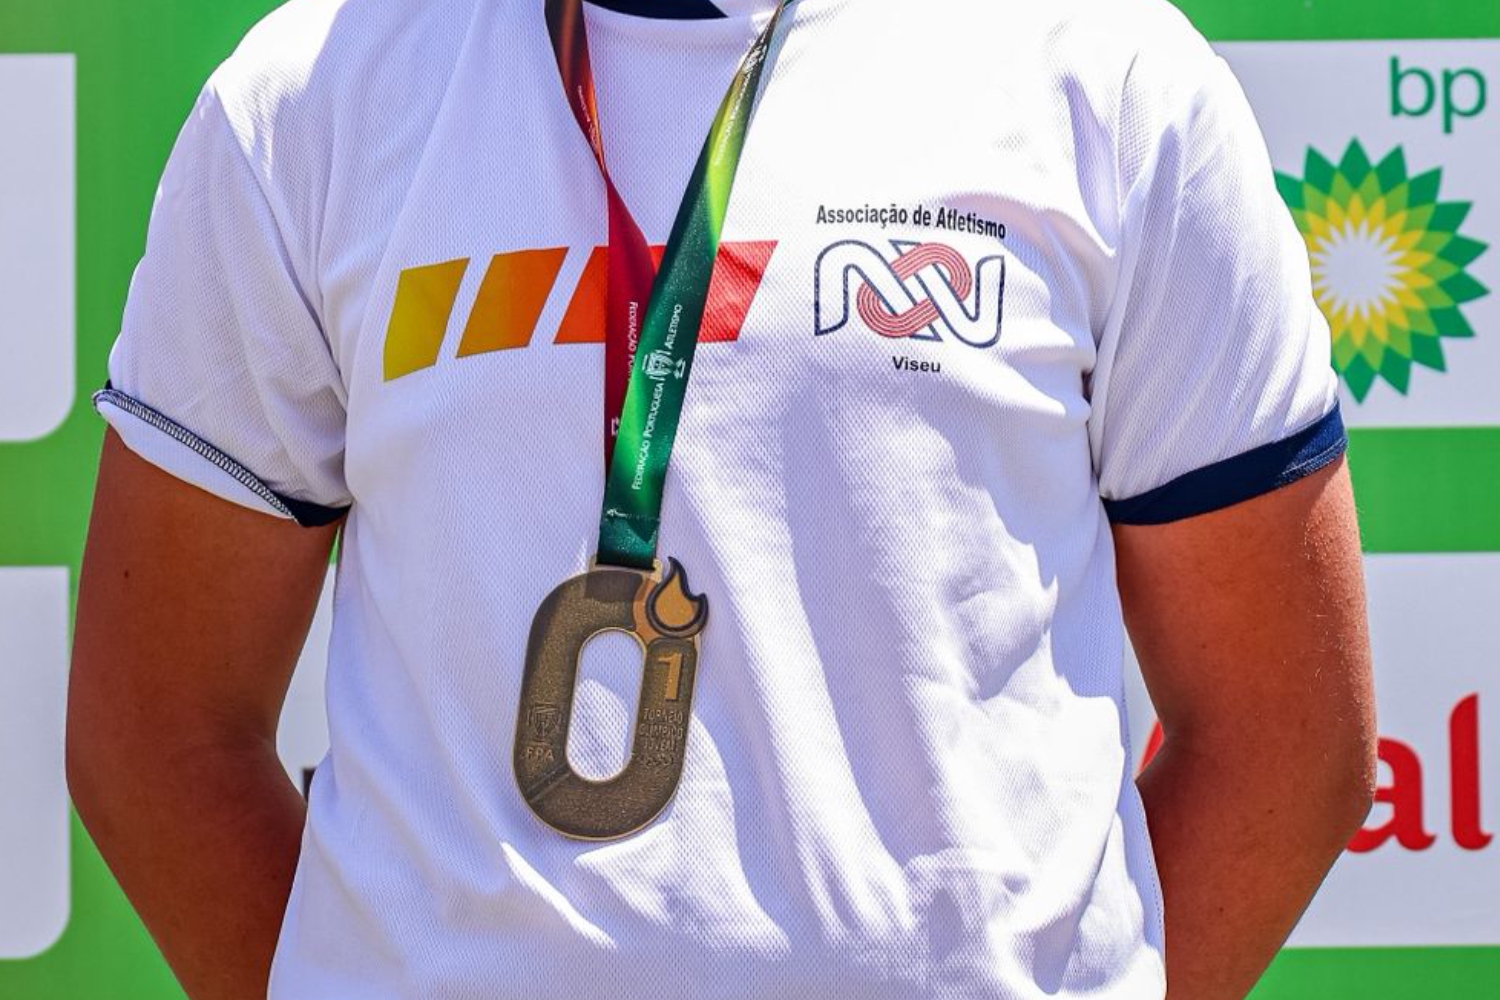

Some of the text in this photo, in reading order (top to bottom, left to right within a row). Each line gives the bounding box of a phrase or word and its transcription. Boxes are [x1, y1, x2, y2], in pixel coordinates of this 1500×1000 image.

[1389, 55, 1487, 135] bp
[816, 203, 1006, 240] Associação de Atletismo
[892, 356, 942, 374] Viseu
[631, 304, 683, 491] FEDERAÇÃO PORTUGUESA ATLETISMO
[657, 652, 683, 700] 1
